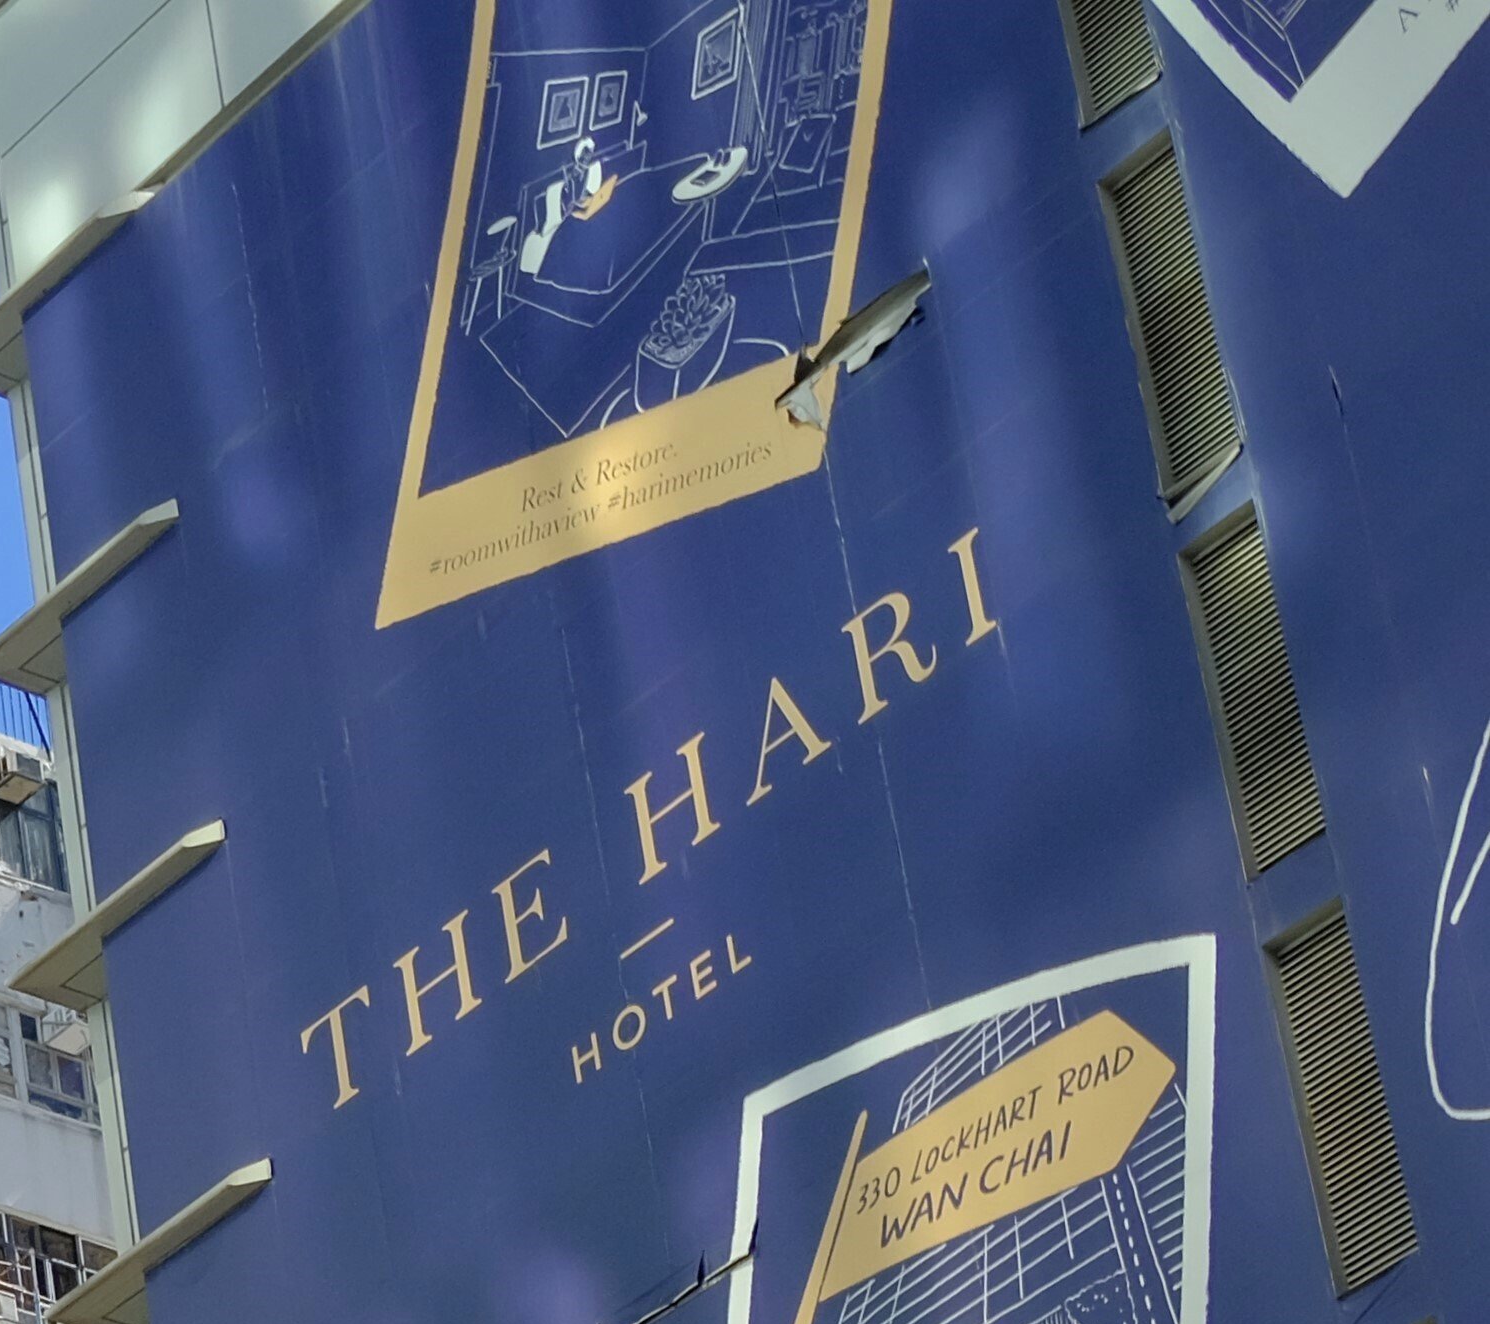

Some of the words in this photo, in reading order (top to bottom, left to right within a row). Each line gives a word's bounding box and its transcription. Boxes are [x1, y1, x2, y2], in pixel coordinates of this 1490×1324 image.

[429, 501, 601, 575] #roomwithaview
[606, 441, 773, 511] #harimemories
[520, 479, 563, 513] Rest
[570, 468, 589, 495] &
[595, 442, 679, 486] Restore.
[300, 848, 568, 1110] THE
[624, 527, 997, 885] HARI
[570, 934, 752, 1084] HOTEL
[857, 1166, 901, 1215] 330
[910, 1085, 1043, 1184] LOCKHART
[1057, 1045, 1135, 1105] ROAD
[880, 1172, 969, 1248] WAN
[978, 1120, 1072, 1195] CHAI
